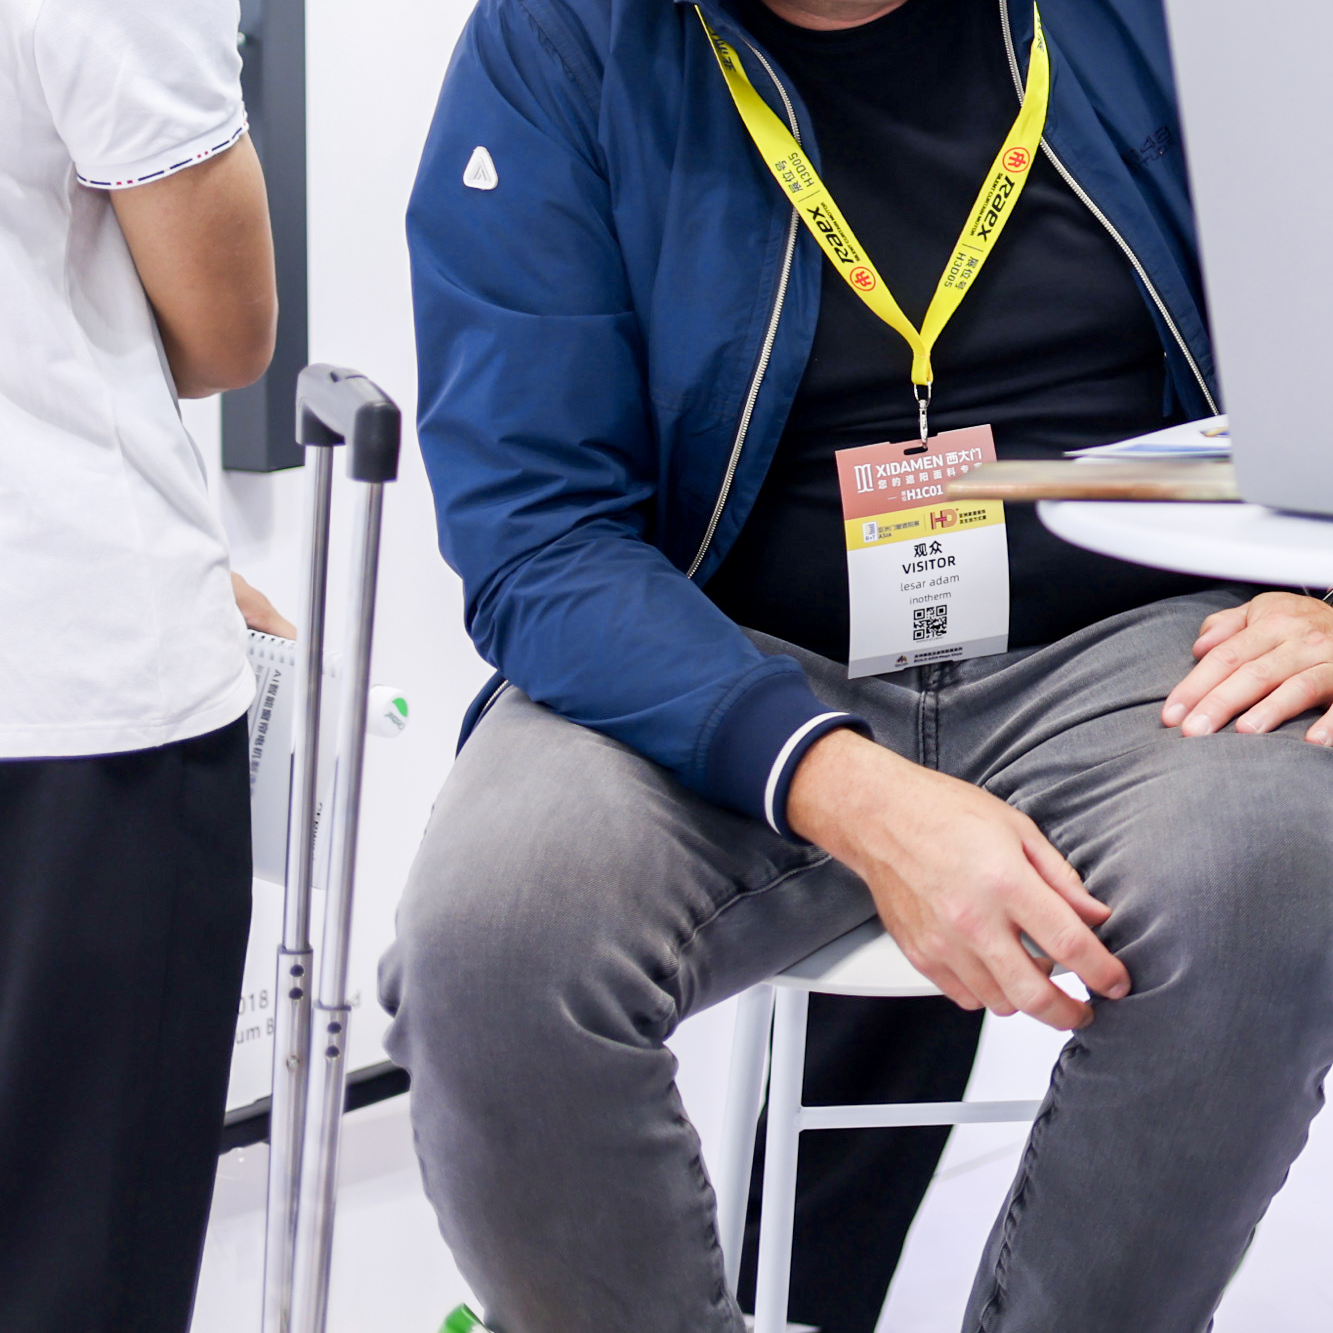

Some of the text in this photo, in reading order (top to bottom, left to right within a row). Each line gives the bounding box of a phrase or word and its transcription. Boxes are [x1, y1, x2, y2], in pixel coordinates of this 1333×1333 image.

[788, 152, 815, 188] H3D05
[977, 175, 1016, 243] Raex
[807, 206, 855, 265] Raex
[944, 252, 967, 288] H3D05
[875, 448, 983, 478] XIDAMEN 西大门
[906, 484, 944, 501] H1C01
[914, 540, 943, 558] 观众
[902, 555, 956, 574] VISITOR
[929, 573, 960, 587] adam
[909, 591, 952, 605] inotherm
